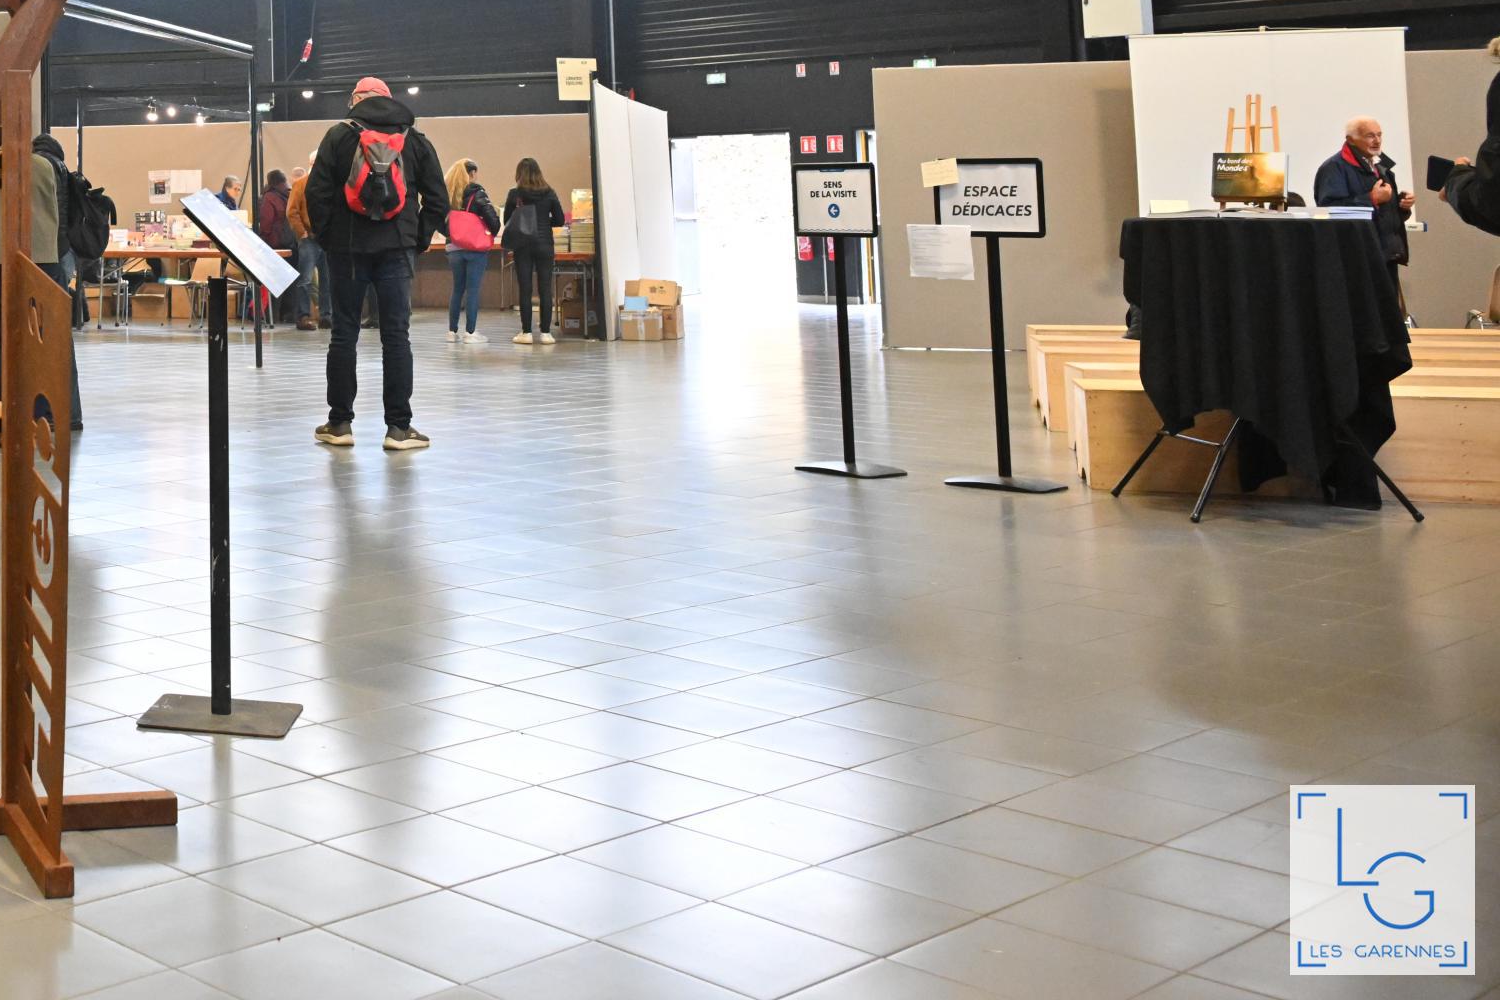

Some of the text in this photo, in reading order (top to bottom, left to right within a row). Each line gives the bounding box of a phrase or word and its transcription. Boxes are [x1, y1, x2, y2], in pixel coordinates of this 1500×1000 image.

[823, 180, 843, 189] SENS
[810, 190, 857, 198] DE LA VISITE
[963, 185, 1018, 198] ESPACE
[952, 201, 1033, 217] DÉDICACES
